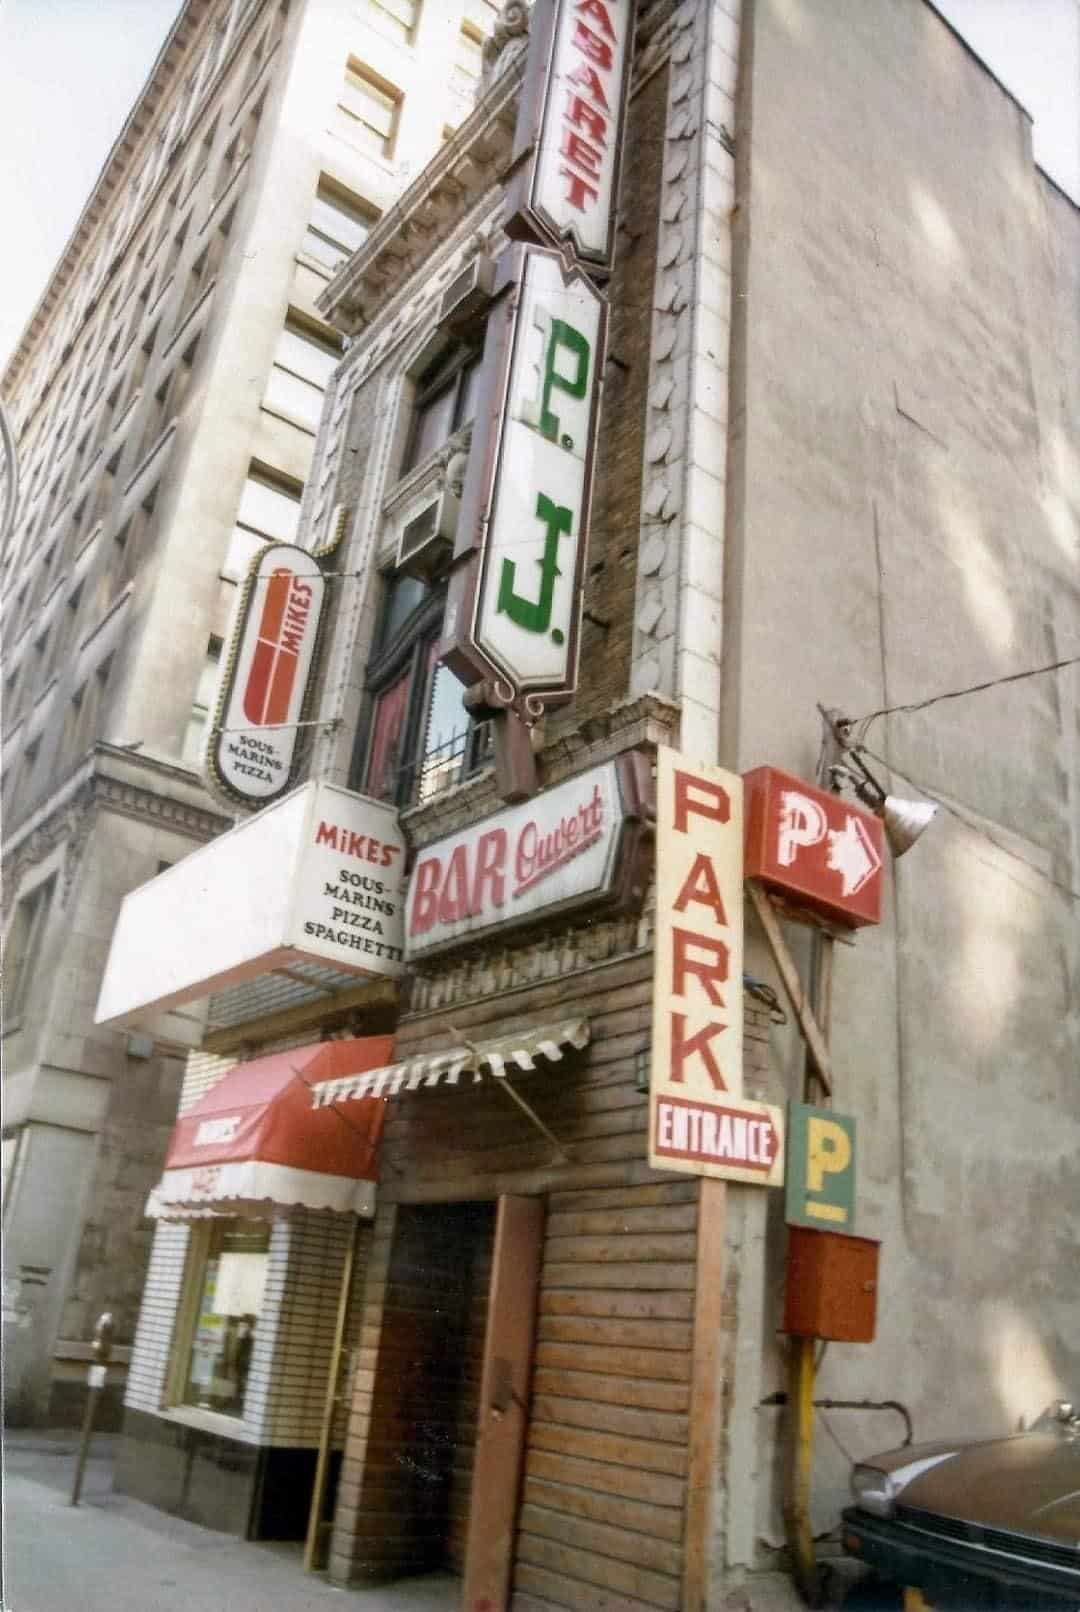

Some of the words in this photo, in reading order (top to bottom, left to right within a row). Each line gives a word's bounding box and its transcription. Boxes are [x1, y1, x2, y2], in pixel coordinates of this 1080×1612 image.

[229, 744, 283, 770] MARINS
[233, 761, 273, 783] PIZZA
[777, 790, 827, 867] P
[409, 827, 508, 938] BAR
[515, 784, 604, 883] Ouvert
[323, 882, 395, 917] MARINS
[331, 906, 384, 936] PIZZA
[670, 768, 731, 1093] PARK
[658, 1103, 774, 1166] ENTRANCE
[806, 1116, 852, 1192] P
